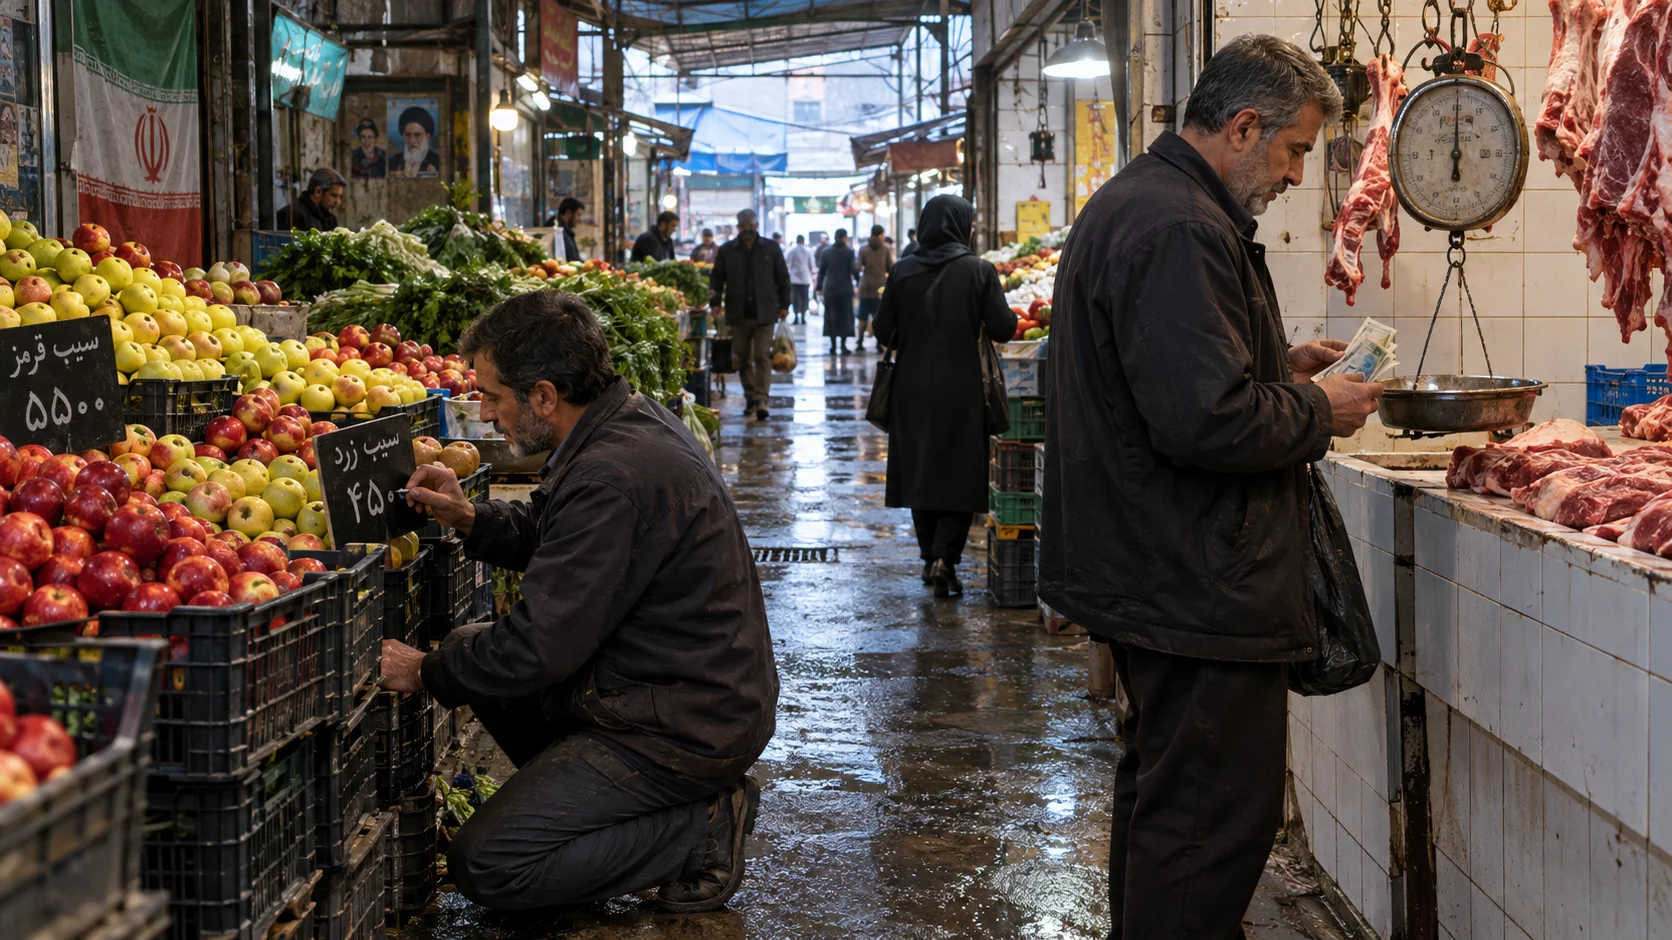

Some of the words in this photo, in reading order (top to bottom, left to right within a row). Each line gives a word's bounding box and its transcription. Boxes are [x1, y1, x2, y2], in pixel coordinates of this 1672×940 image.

[9, 333, 46, 378] قرمز
[53, 336, 99, 365] سیب
[25, 386, 104, 431] ۵۵۰۰
[334, 440, 358, 472] زرد
[363, 433, 400, 462] سیب
